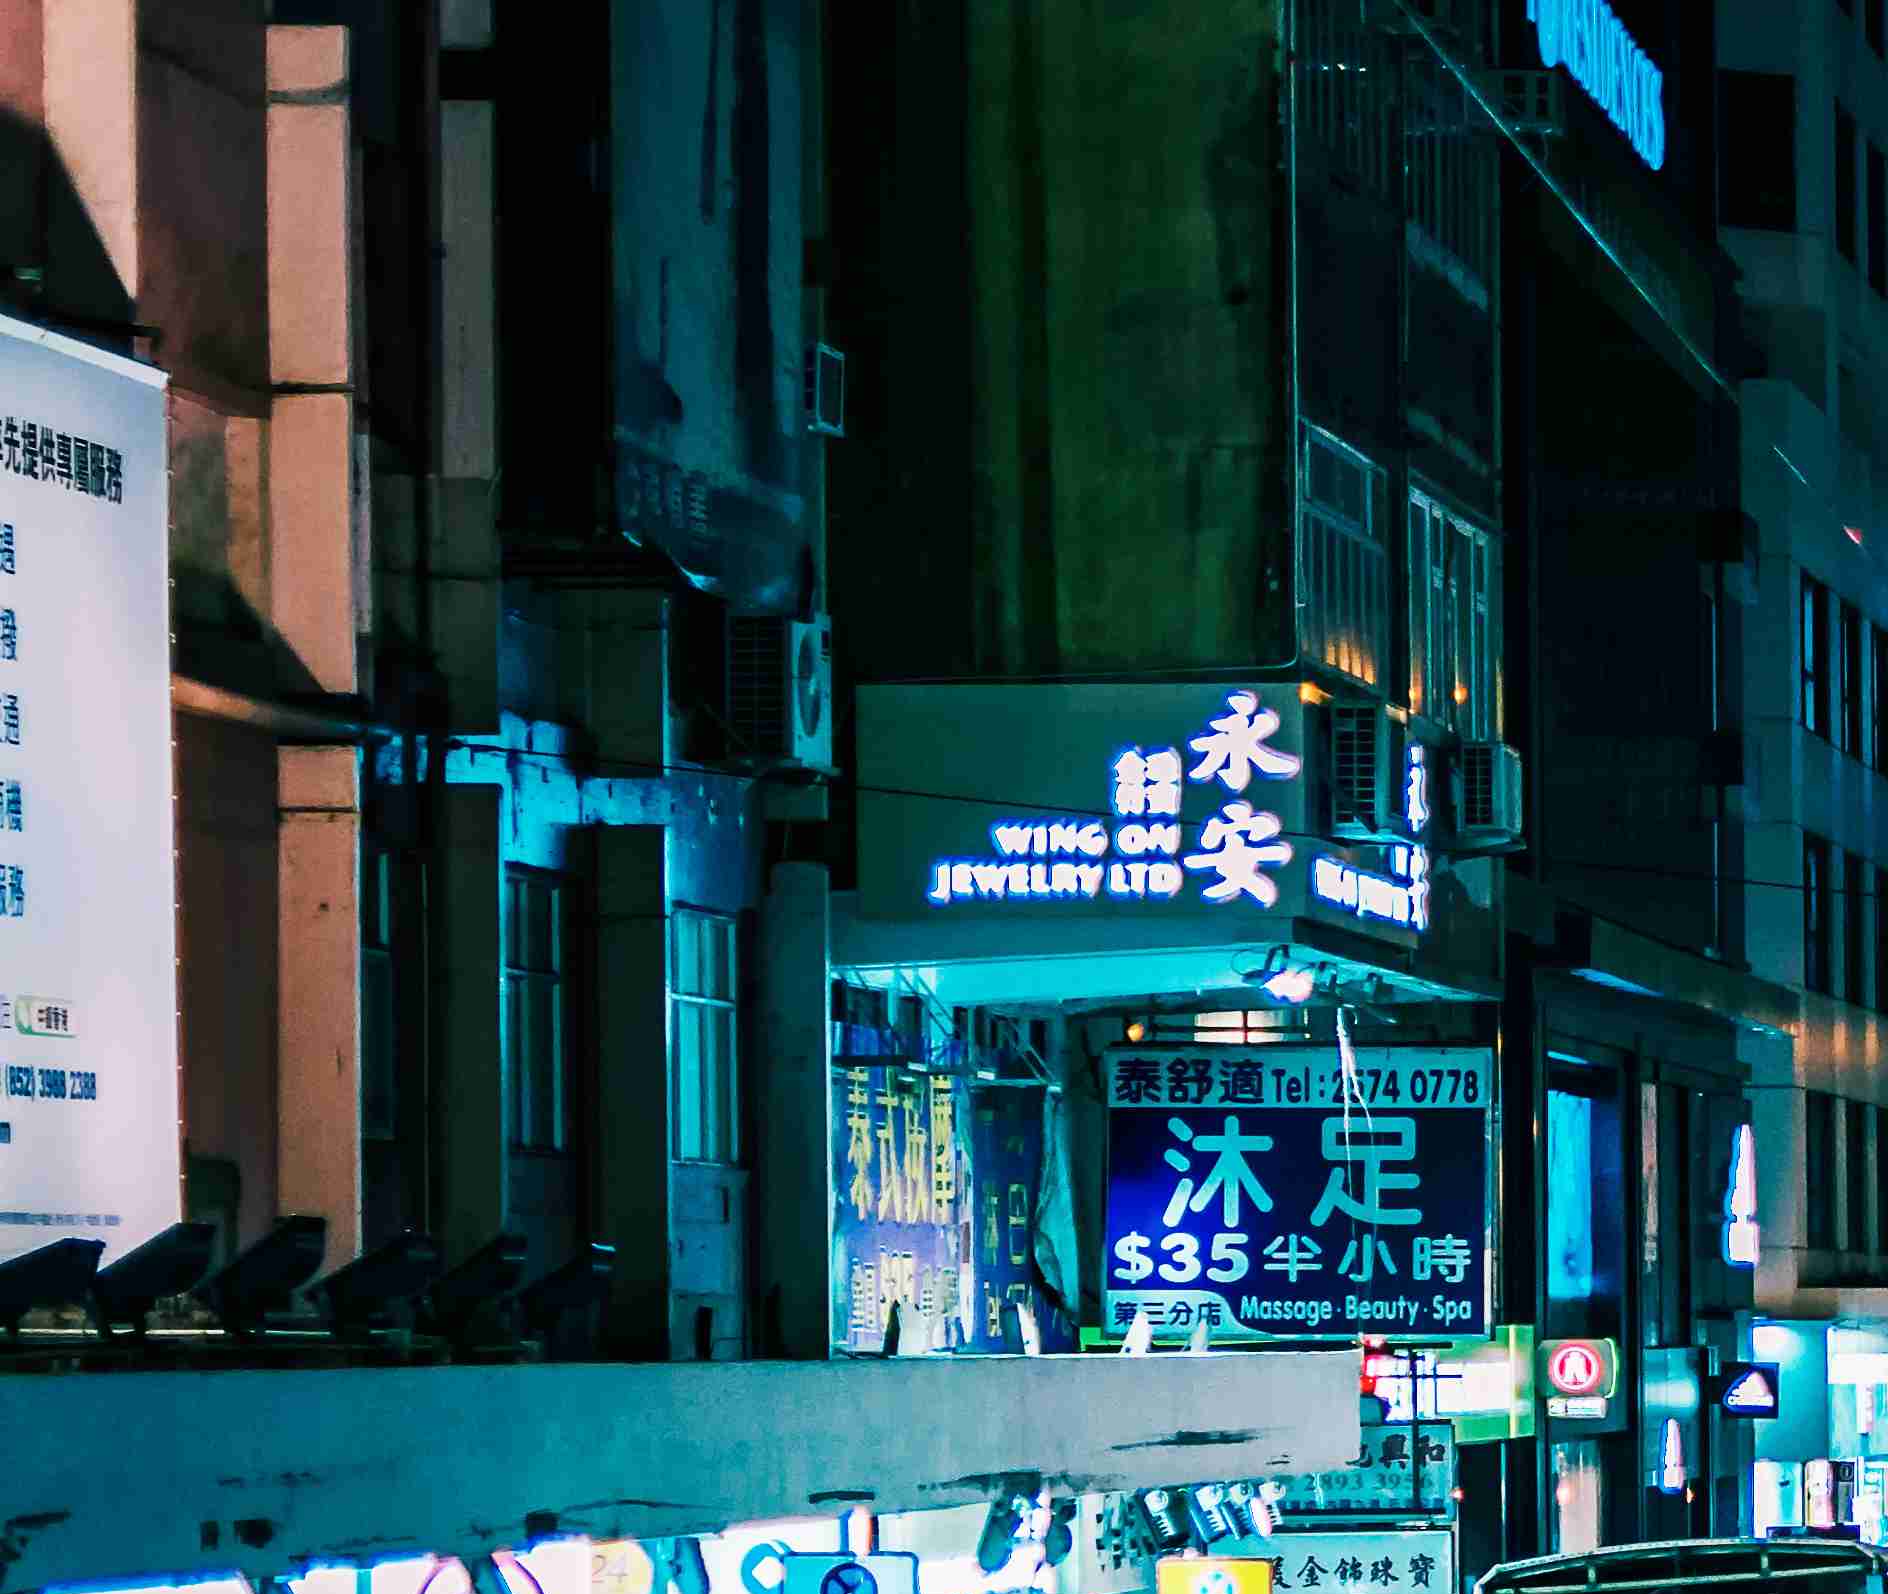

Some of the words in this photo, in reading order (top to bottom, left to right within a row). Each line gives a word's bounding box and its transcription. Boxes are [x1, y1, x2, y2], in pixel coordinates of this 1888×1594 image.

[1185, 690, 1300, 907] 永安
[995, 825, 1106, 856] WING
[1116, 825, 1180, 856] ON
[928, 863, 1103, 902] JEWELRY
[1109, 863, 1182, 897] LTD
[1115, 1057, 1265, 1104] 泰舒適
[1410, 1068, 1479, 1104] 0778
[1161, 1114, 1423, 1228] 沐足
[1112, 1231, 1250, 1285] $35
[1262, 1233, 1472, 1284] 半小時
[1240, 1295, 1333, 1322] Massage
[1345, 1296, 1420, 1327] Beauty
[1432, 1297, 1472, 1325] Spa
